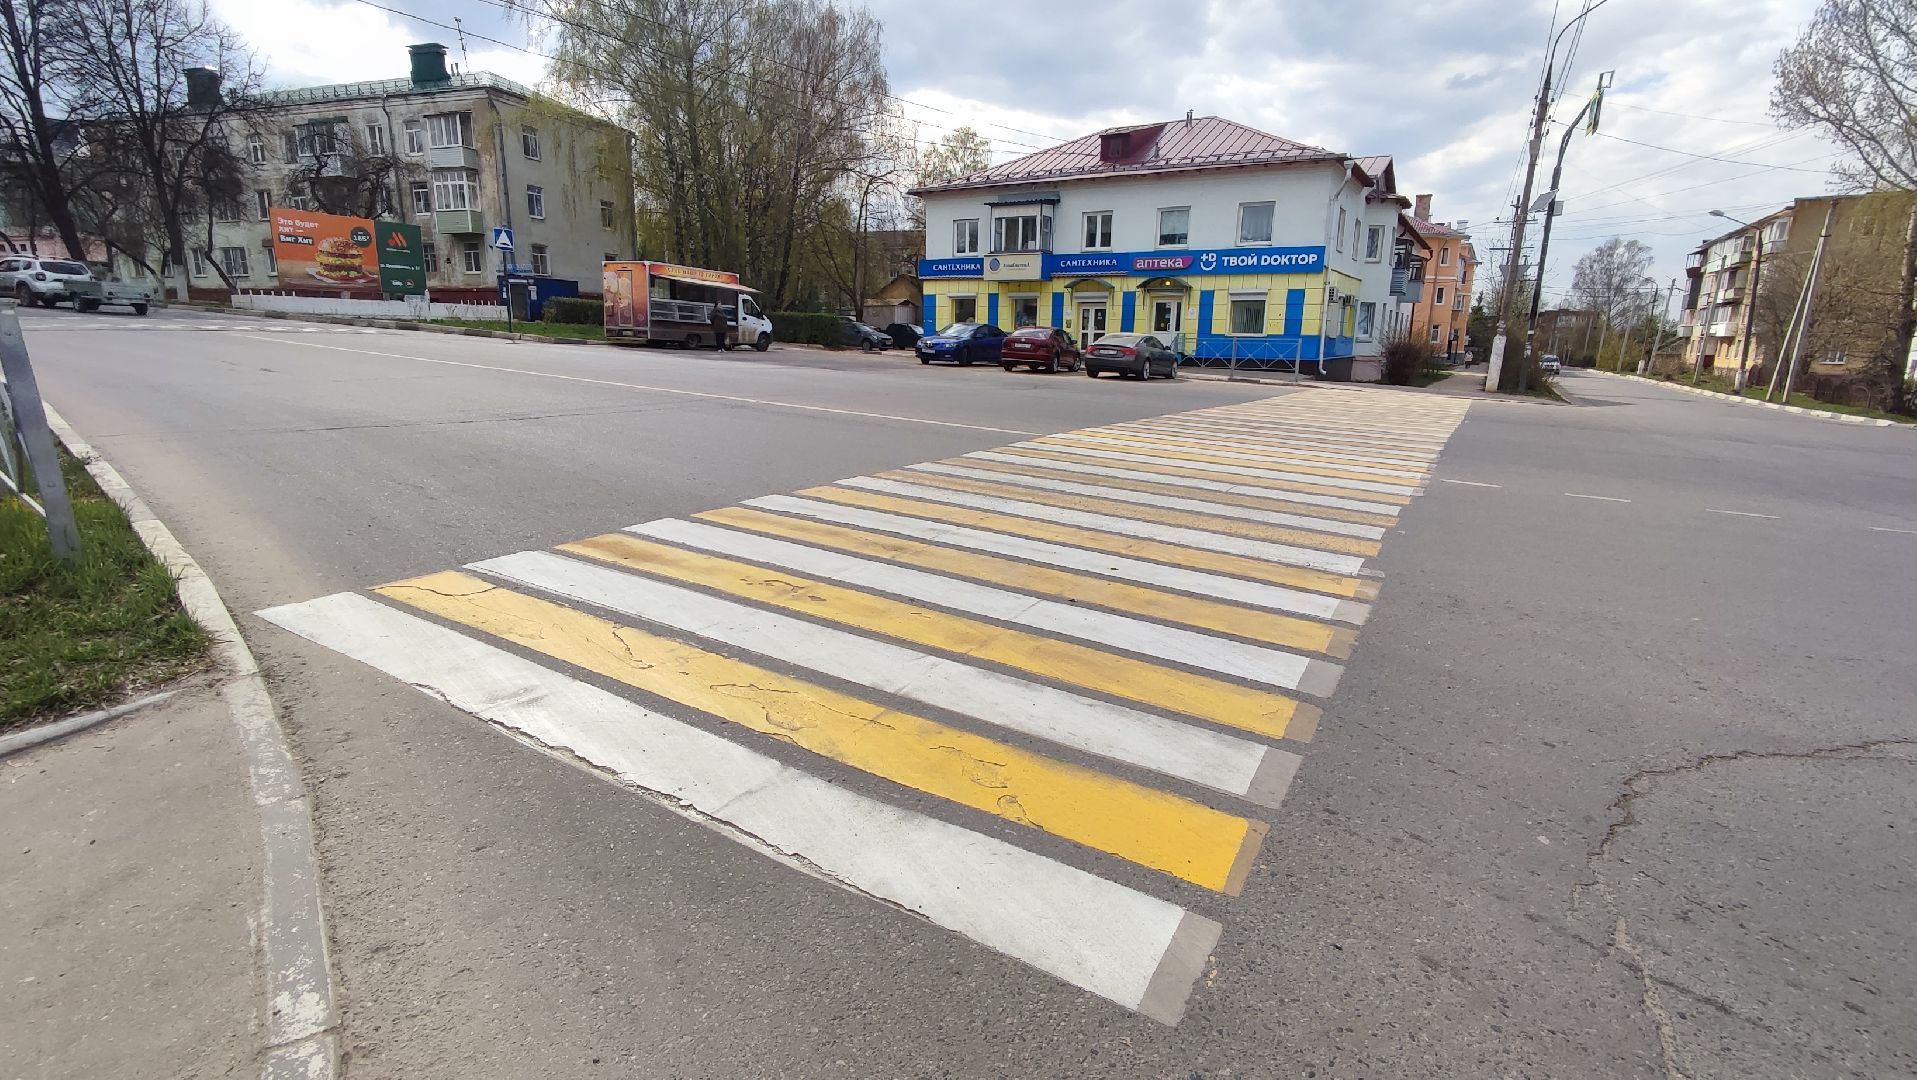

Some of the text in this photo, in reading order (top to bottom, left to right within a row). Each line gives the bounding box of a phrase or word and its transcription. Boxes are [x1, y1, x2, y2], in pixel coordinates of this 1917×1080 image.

[277, 217, 319, 228] Это будет
[1060, 258, 1118, 268] САНТЕХНИКА
[1136, 257, 1184, 269] аптека
[1222, 253, 1258, 267] ТВОЙ
[932, 263, 981, 271] САНТЕХНИКА
